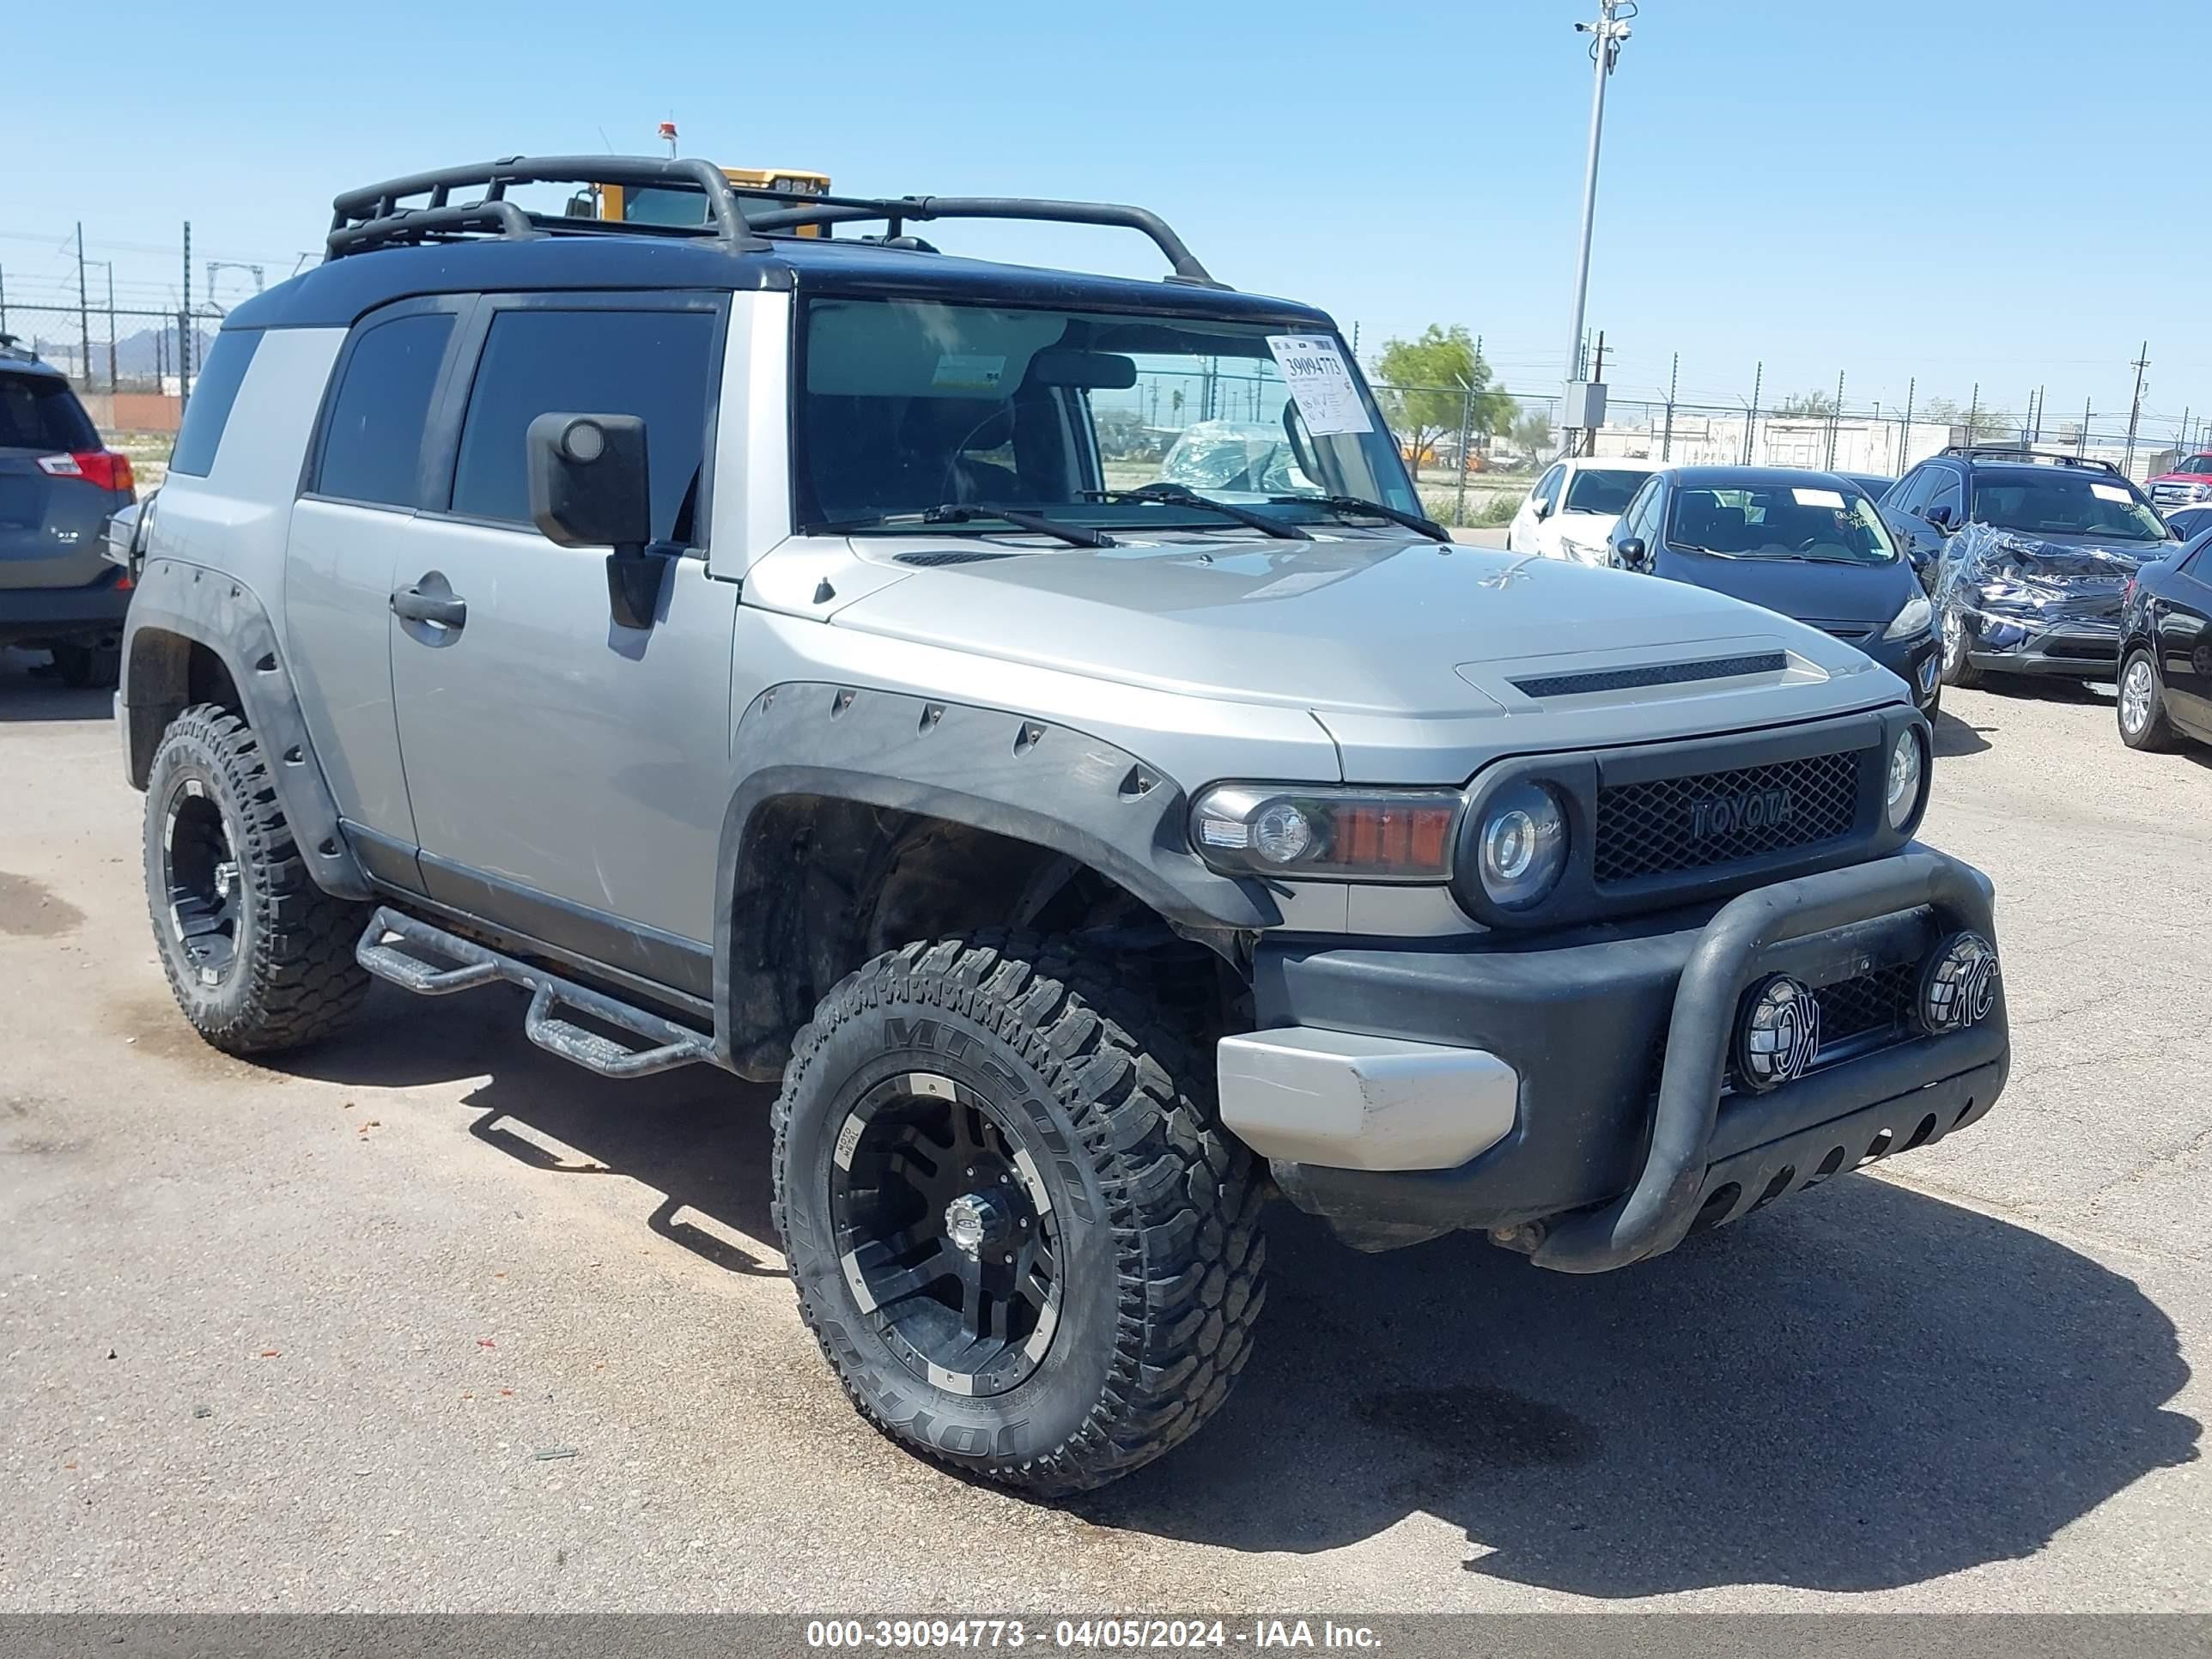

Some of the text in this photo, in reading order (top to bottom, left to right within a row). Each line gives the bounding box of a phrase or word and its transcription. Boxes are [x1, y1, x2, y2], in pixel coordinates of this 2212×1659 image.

[1285, 356, 1341, 377] 39094773
[1691, 788, 1793, 839] TOYOTA
[1953, 952, 2000, 1027] KC
[837, 1127, 852, 1152] MOTO
[843, 1131, 860, 1159] METAL
